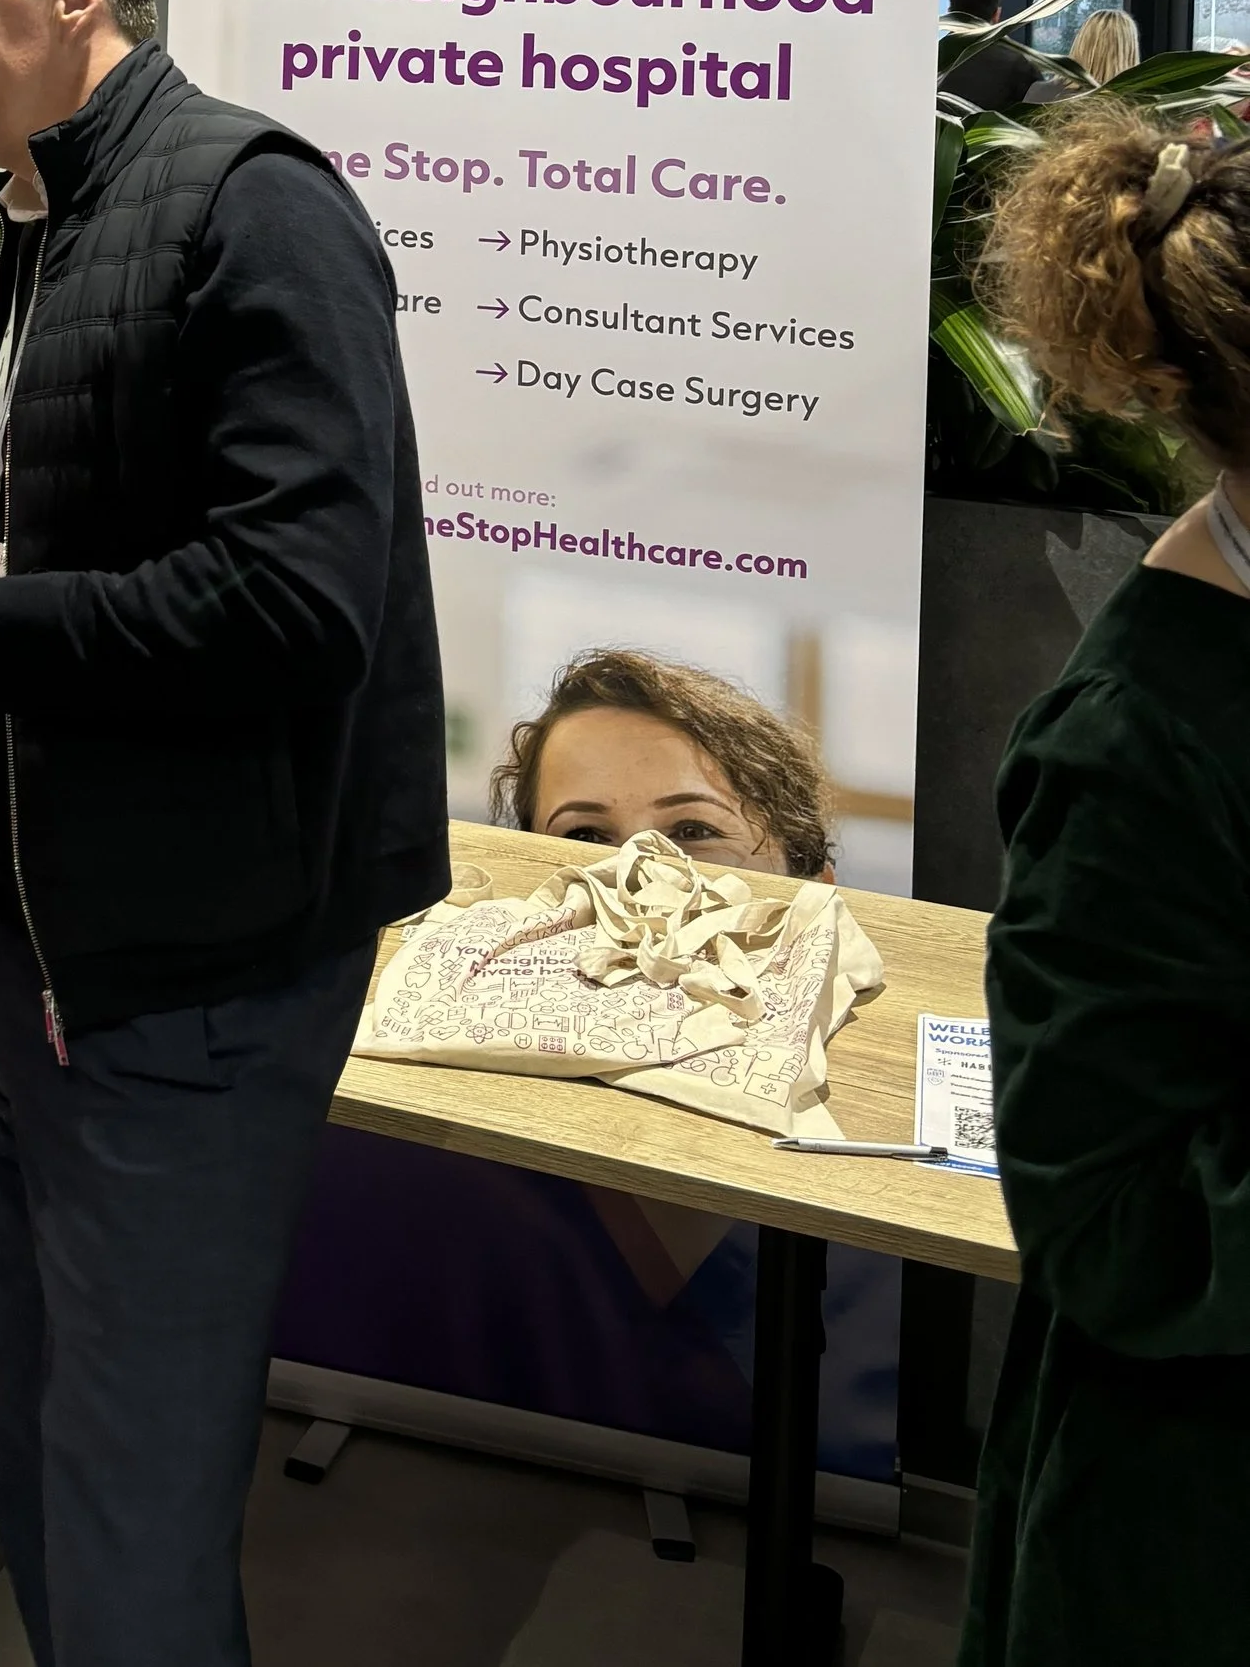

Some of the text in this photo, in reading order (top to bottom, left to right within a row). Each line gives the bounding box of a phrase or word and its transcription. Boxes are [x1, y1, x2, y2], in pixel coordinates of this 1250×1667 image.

[281, 28, 792, 109] private hospital
[322, 142, 787, 205] ne Stop. Total Care.
[520, 228, 759, 281] Physiotherapy
[518, 294, 855, 350] Consultant Services
[517, 360, 820, 422] Day Case Surgery
[445, 482, 485, 499] out
[490, 486, 556, 507] more:
[424, 511, 808, 579] neStopHealthcare.com
